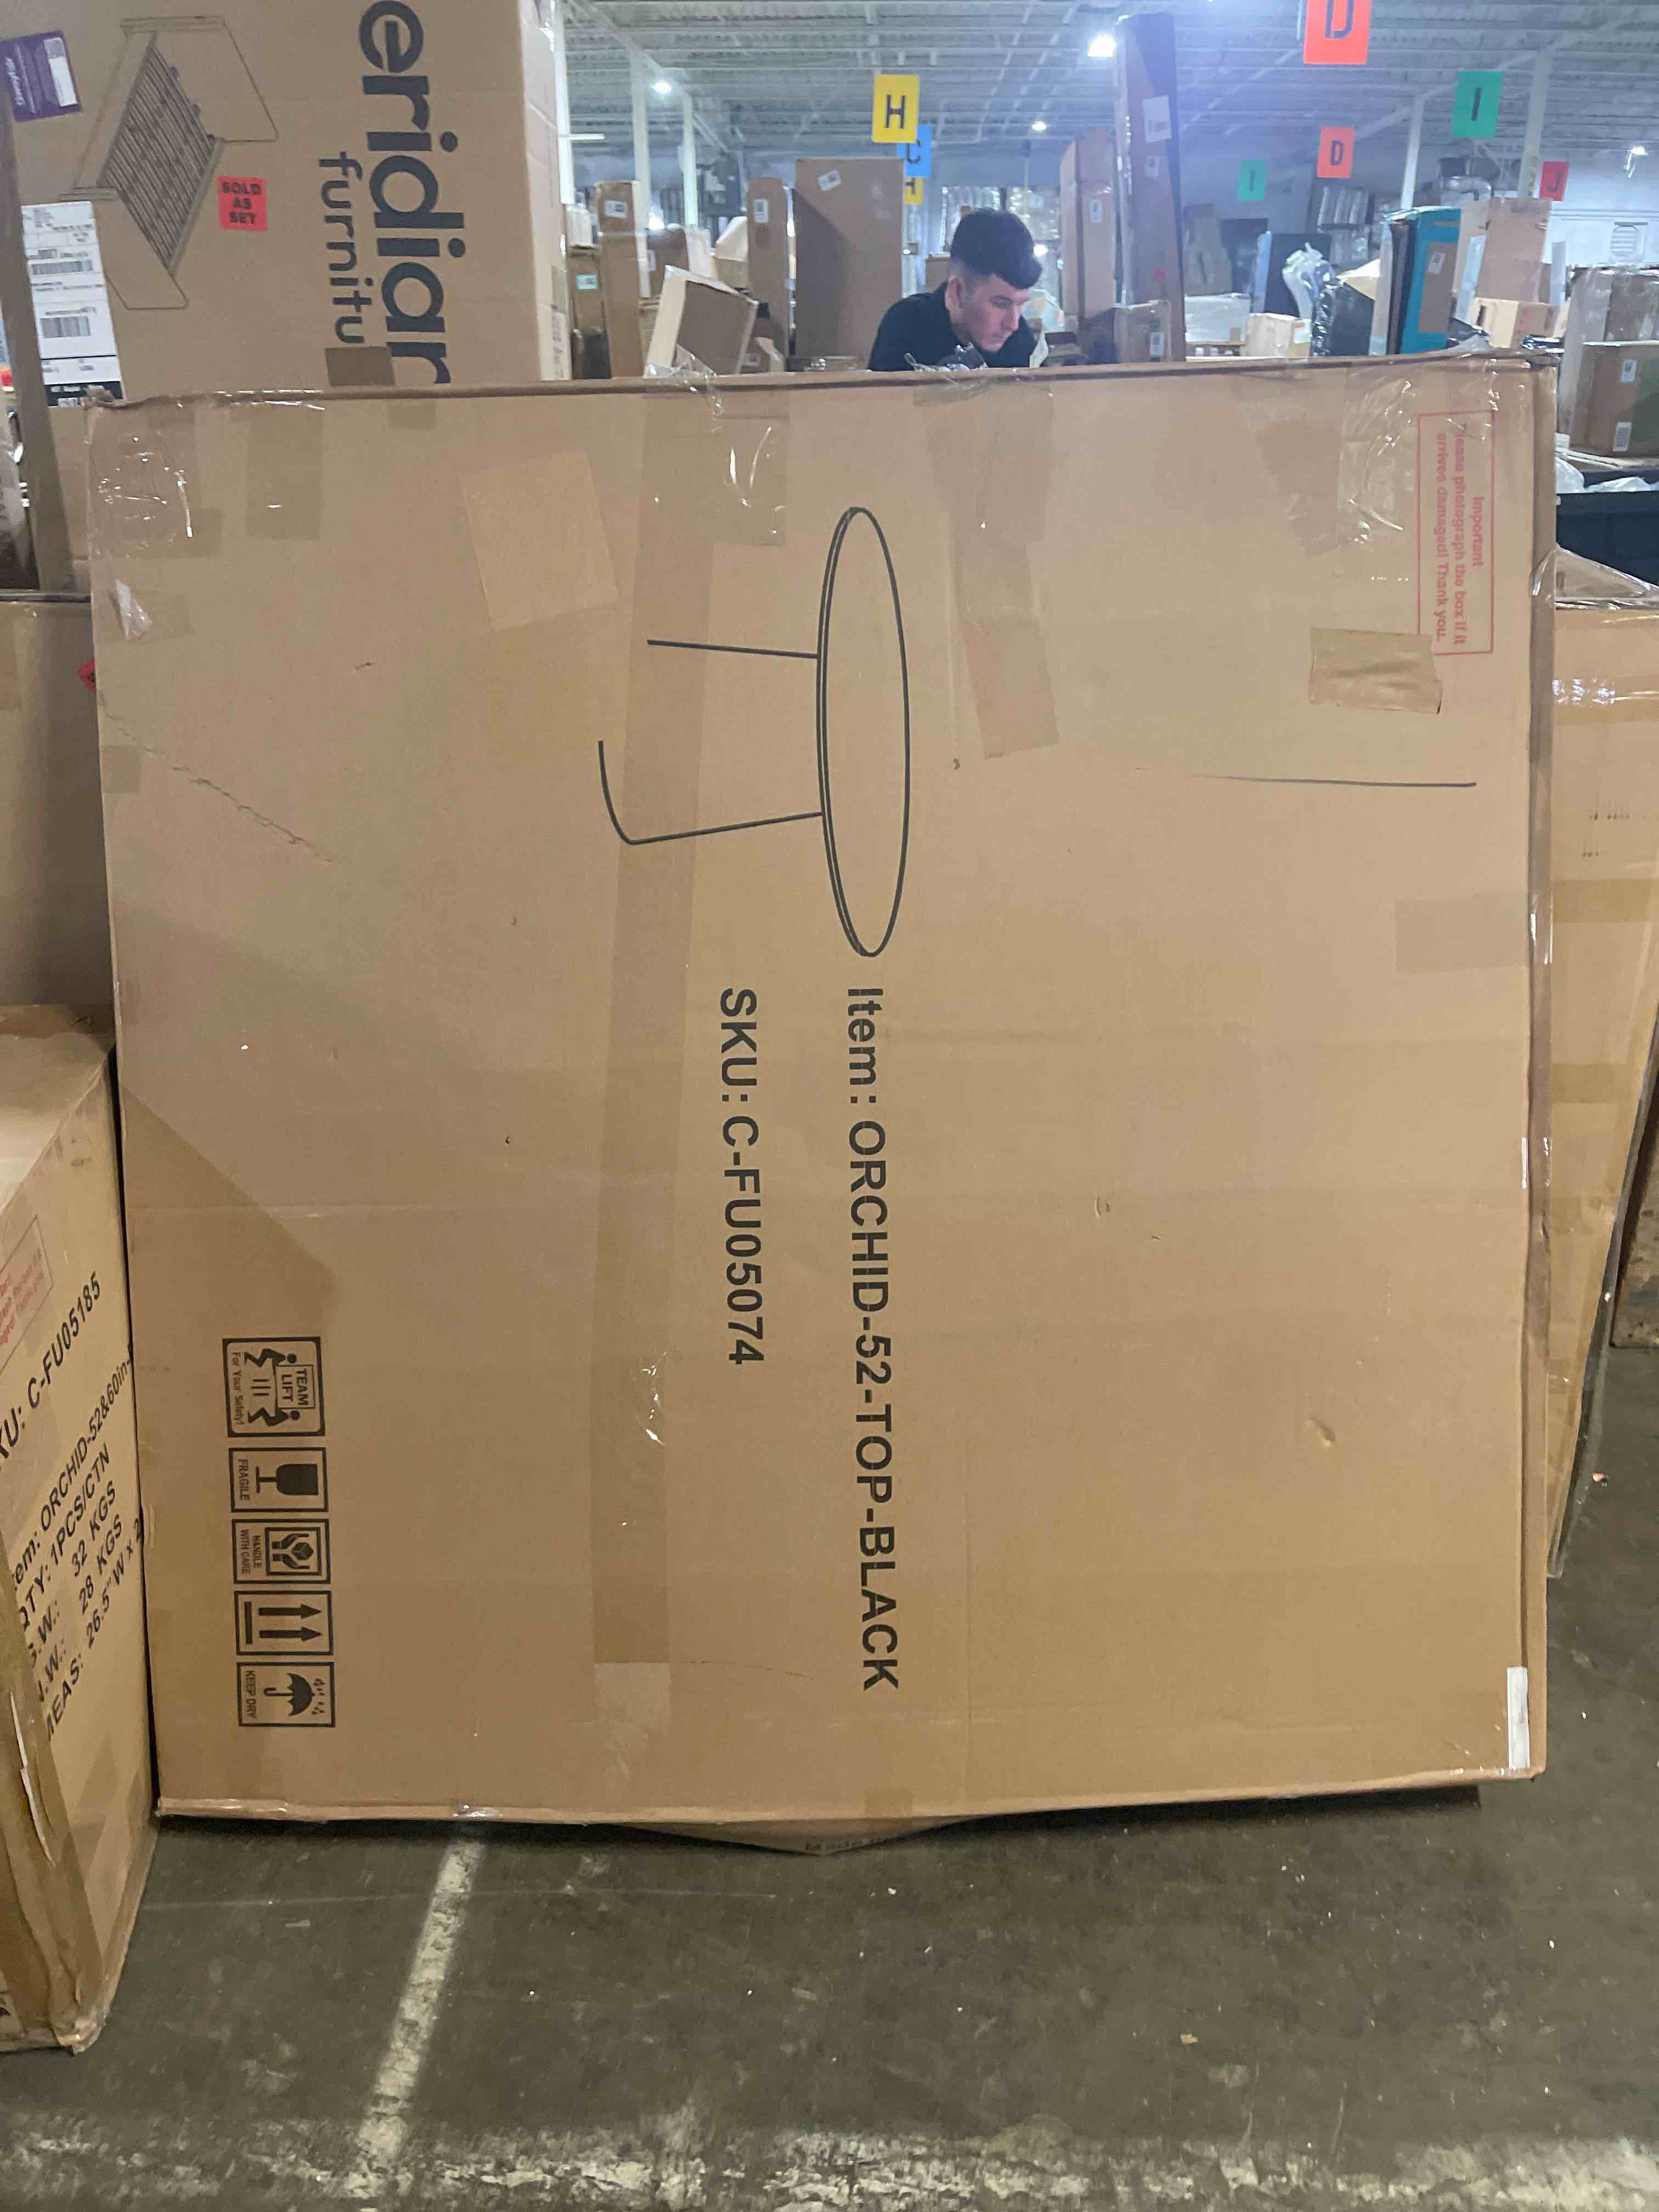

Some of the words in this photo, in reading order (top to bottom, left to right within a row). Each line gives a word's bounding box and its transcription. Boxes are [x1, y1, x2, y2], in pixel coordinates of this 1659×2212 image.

[1325, 0, 1355, 38] D
[885, 94, 905, 129] H
[1471, 87, 1481, 121] I
[1330, 140, 1344, 165] D
[222, 181, 261, 194] SOLD
[233, 197, 251, 210] AS
[228, 211, 255, 224] SET
[1437, 431, 1449, 483] arrives
[1453, 477, 1466, 560] photograph
[1437, 562, 1449, 606] Thank
[1455, 564, 1466, 586] the
[1455, 591, 1466, 617] box
[720, 988, 758, 1102] SKU:
[723, 1115, 764, 1365] C-FU05074
[28, 1271, 100, 1409] C-FU05185
[232, 1352, 241, 1366] For
[233, 1370, 242, 1391] Your
[281, 1373, 294, 1402] LIFT
[296, 1368, 308, 1406] TEAM
[848, 1120, 899, 1691] ORCHID-52-TOP-BLACK
[238, 1459, 250, 1501] FRAGILE
[51, 1442, 110, 1566] 1PCS/CTN
[72, 1540, 87, 1577] 32
[89, 1480, 115, 1542] KGS
[240, 1528, 250, 1550] WITH
[79, 1575, 93, 1616] 28
[97, 1514, 122, 1576] KGS
[241, 1551, 251, 1574] CARE
[253, 1535, 262, 1567] HANDLE
[245, 1670, 256, 1695] KEEP
[246, 1698, 257, 1718] DRY
